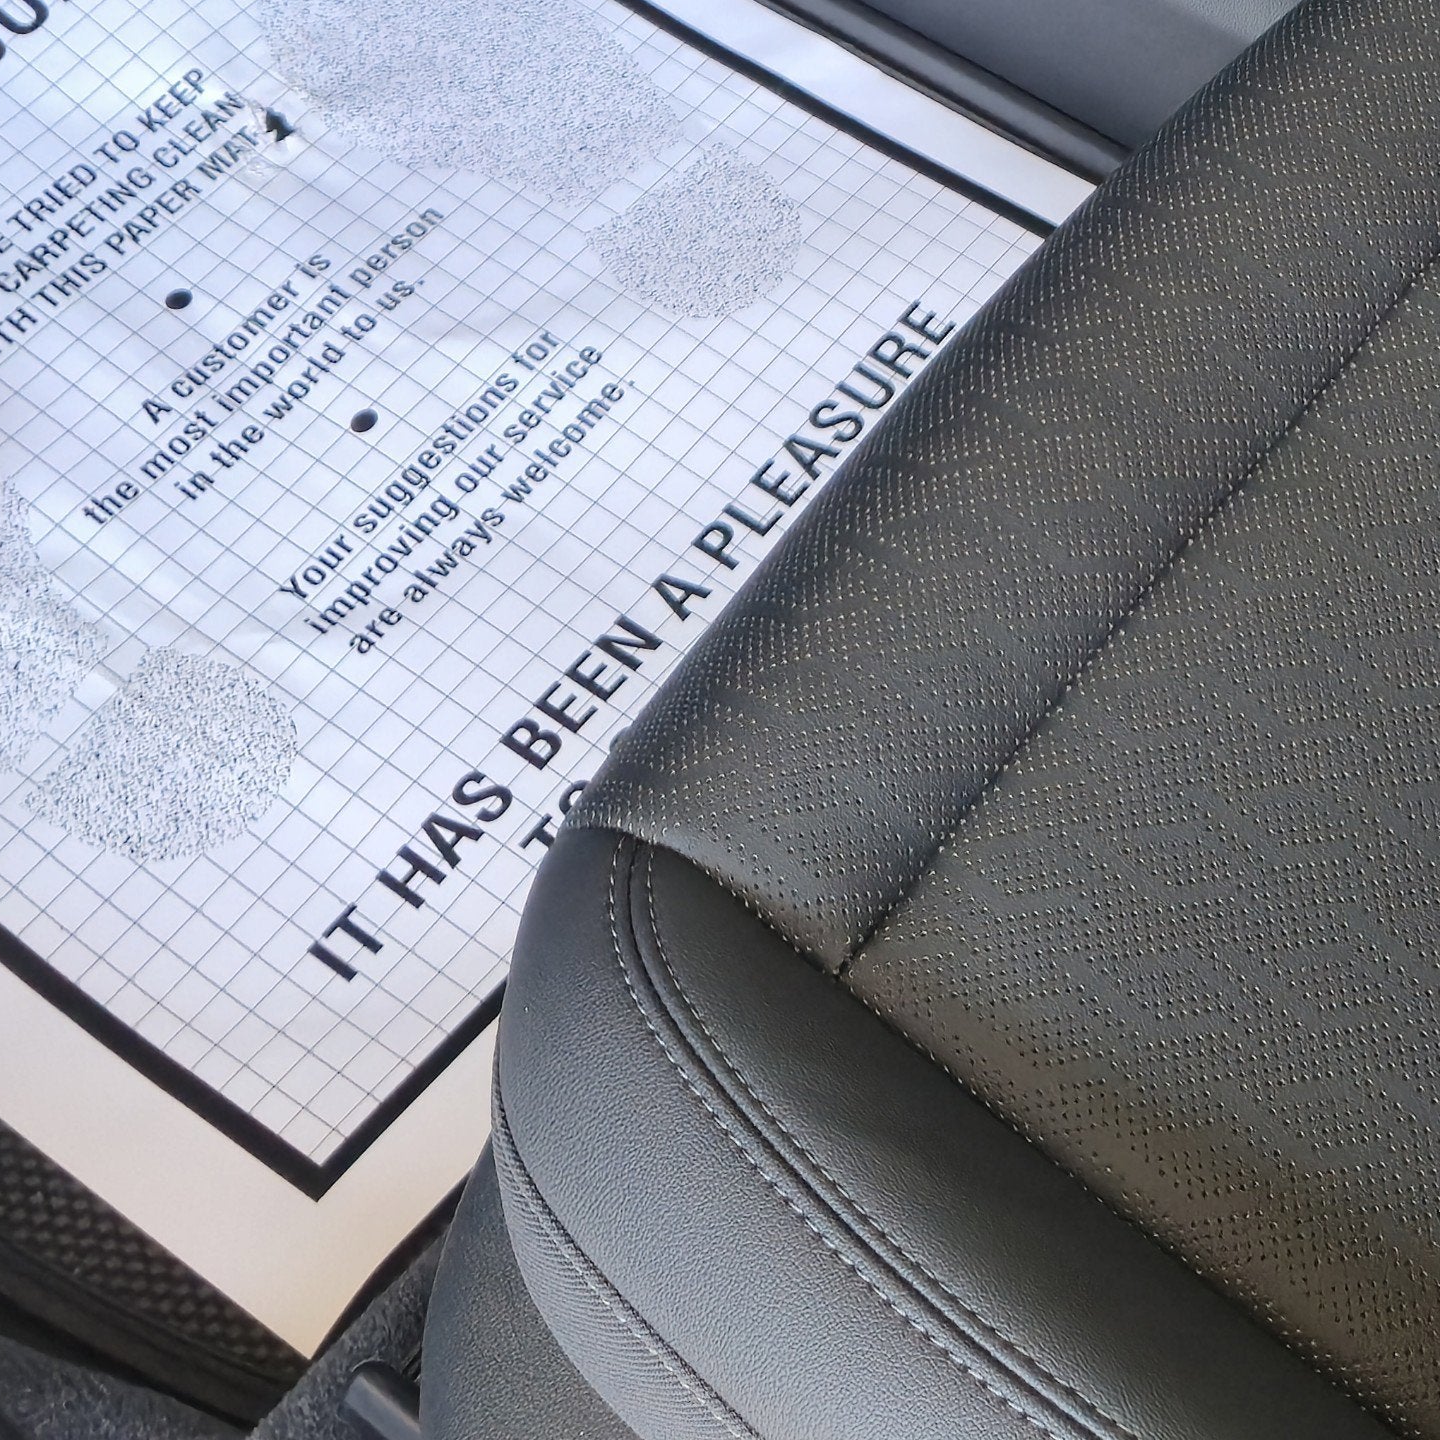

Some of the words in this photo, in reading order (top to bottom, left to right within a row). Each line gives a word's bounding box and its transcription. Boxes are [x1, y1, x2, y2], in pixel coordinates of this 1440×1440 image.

[11, 161, 99, 235] TRIED
[95, 129, 140, 168] TO
[135, 67, 208, 134] KEEP
[32, 252, 110, 314] THIS
[106, 179, 202, 256] PAPER
[155, 92, 244, 171] CLEAN
[84, 478, 139, 526] the
[139, 409, 218, 479] most
[211, 279, 352, 408] important
[349, 202, 445, 295] person
[141, 395, 168, 423] A
[169, 281, 302, 408] customer
[301, 251, 333, 286] is
[172, 461, 218, 501] in
[210, 417, 266, 472] the
[260, 339, 346, 429] world
[342, 304, 380, 348] to
[378, 273, 428, 311] us.
[279, 529, 357, 601] Your
[352, 370, 521, 532] suggestions
[513, 326, 561, 376] for
[304, 495, 460, 636] improving
[452, 436, 509, 495] our
[502, 345, 604, 445] service
[351, 606, 404, 658] are
[402, 504, 507, 604] always
[501, 376, 635, 511] welcome.
[306, 903, 385, 982] IT
[376, 768, 515, 910] HAS
[501, 613, 664, 772] BEEN
[649, 571, 714, 621] A
[692, 298, 958, 571] PLEASURE
